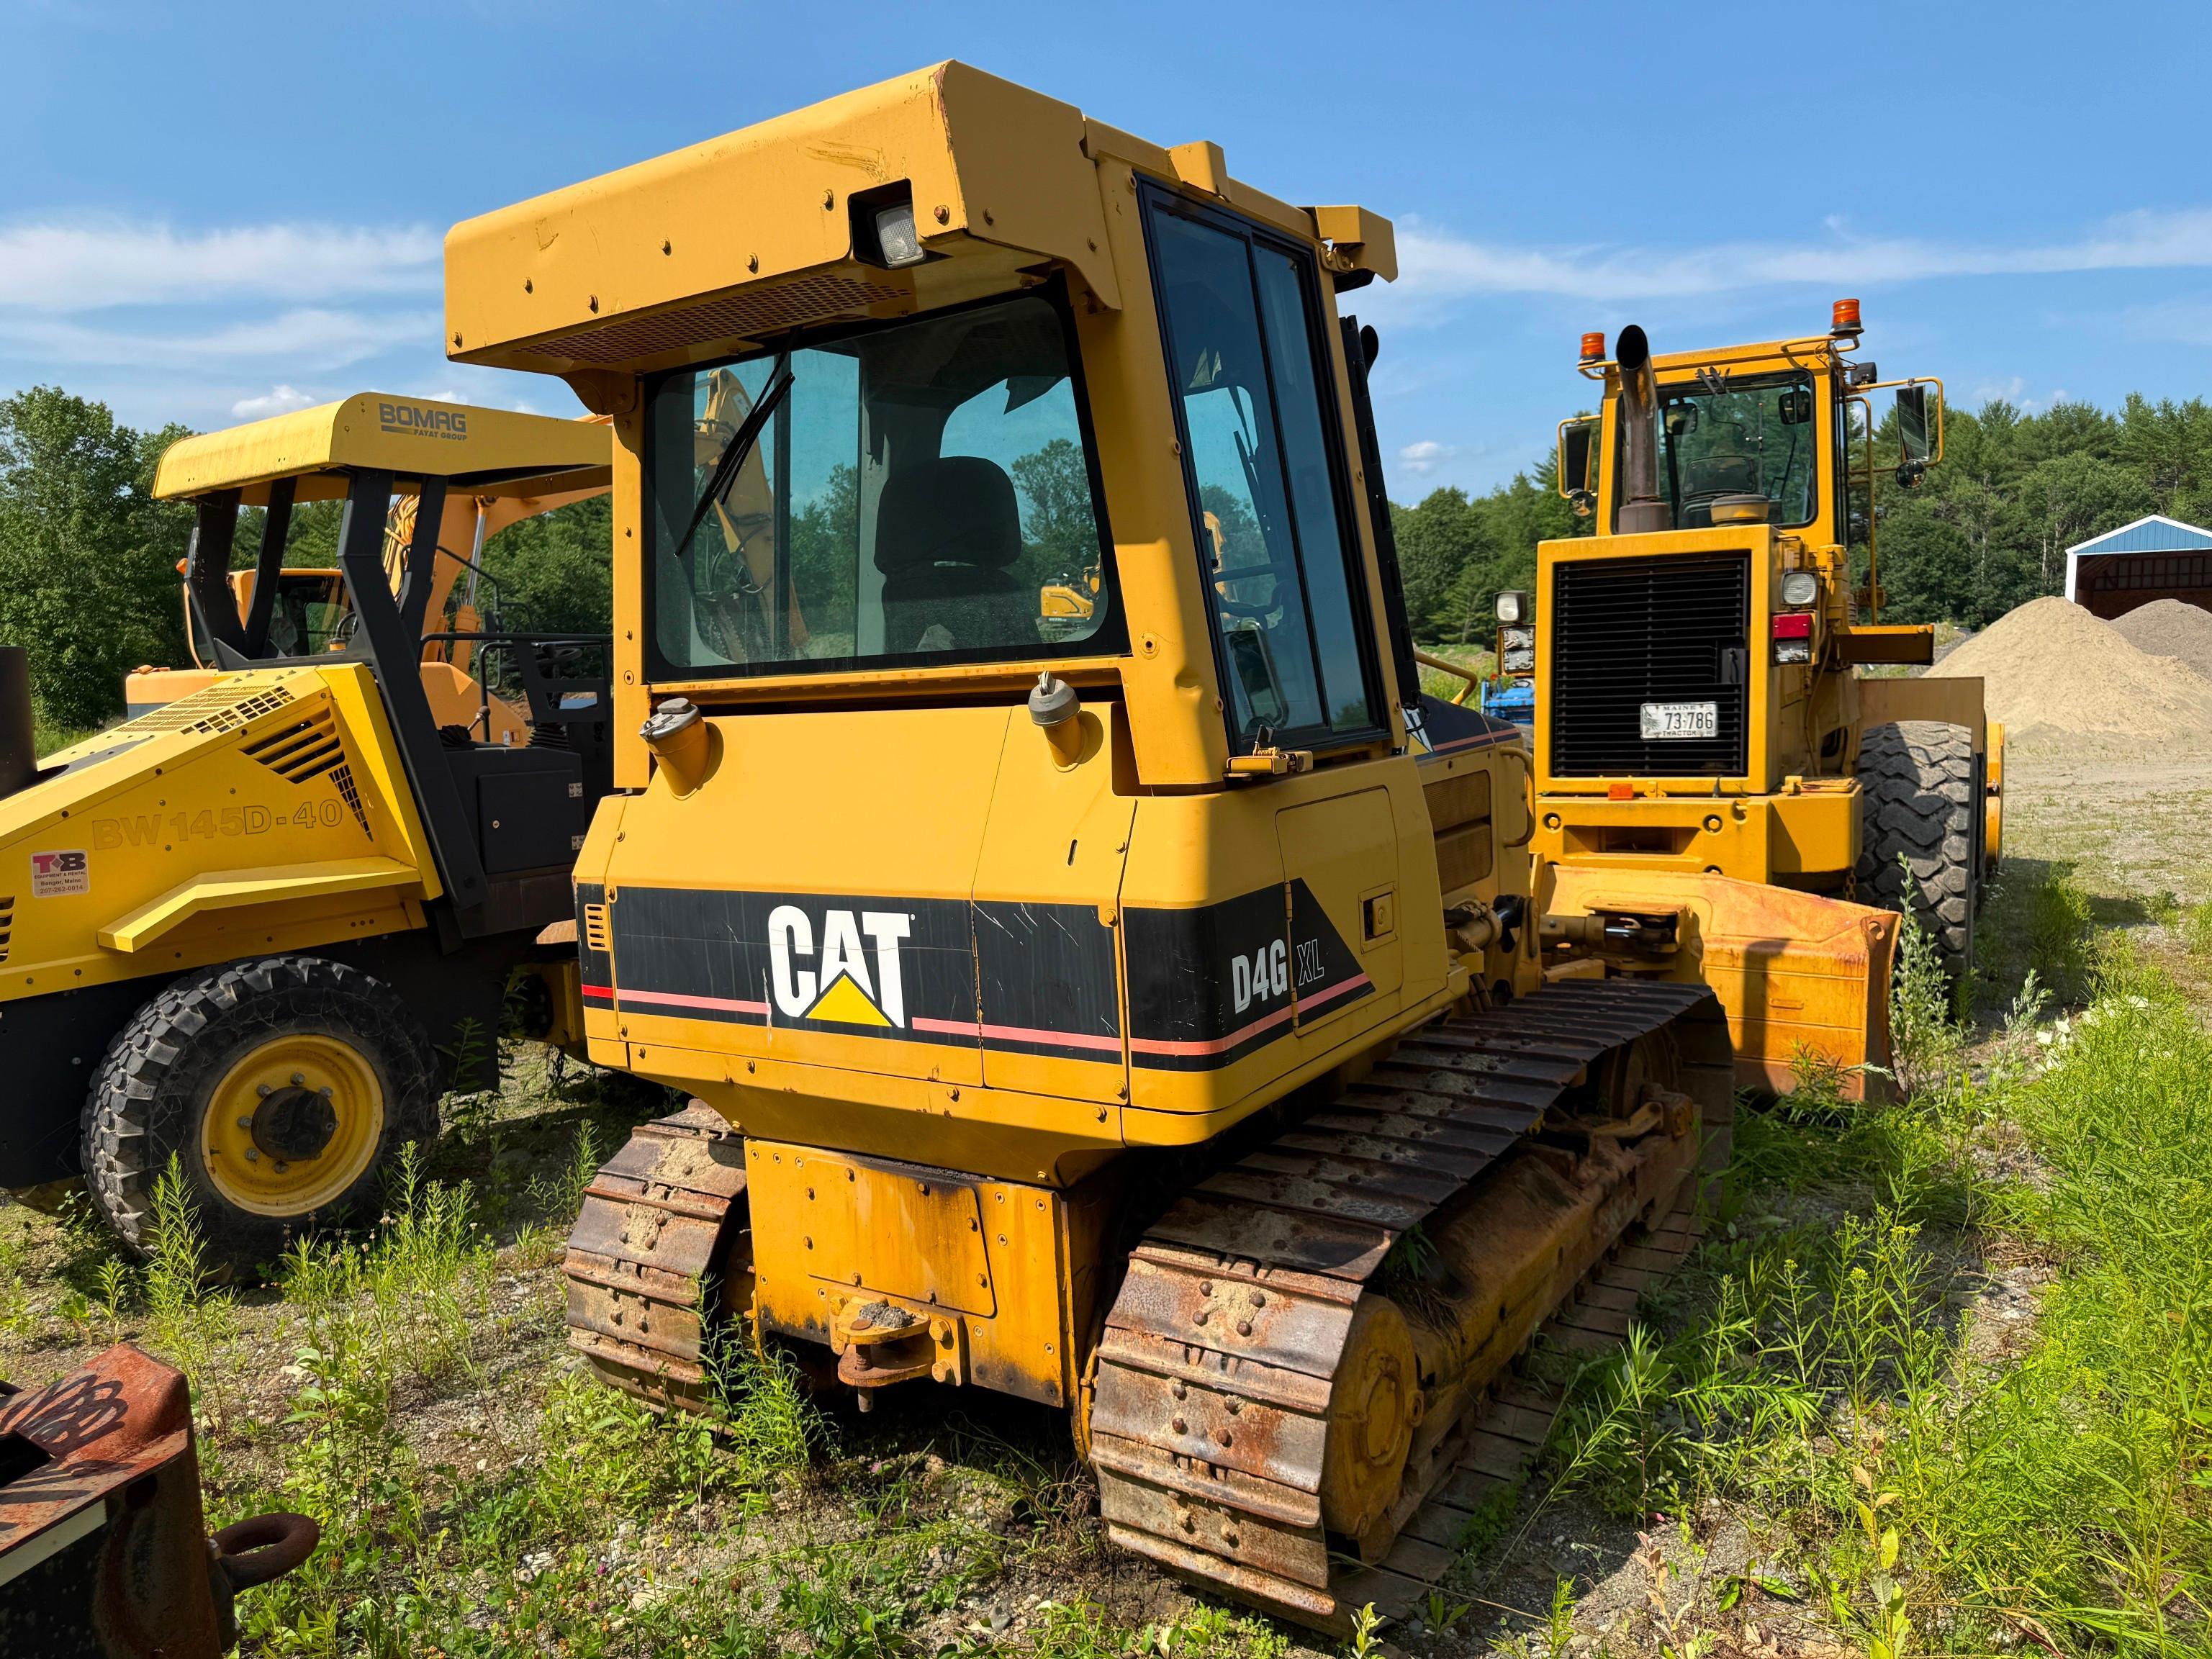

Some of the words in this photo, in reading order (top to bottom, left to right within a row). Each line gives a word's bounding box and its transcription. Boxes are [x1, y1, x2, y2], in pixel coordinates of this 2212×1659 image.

[379, 402, 466, 433] BOMAG
[414, 429, 438, 438] FAYAT
[91, 814, 161, 851] BW
[169, 799, 343, 841] 145D-40
[40, 885, 83, 894] 207-262-0014
[768, 905, 911, 1029] CAT
[1232, 939, 1288, 1014] D4G
[1296, 939, 1324, 987] XL
